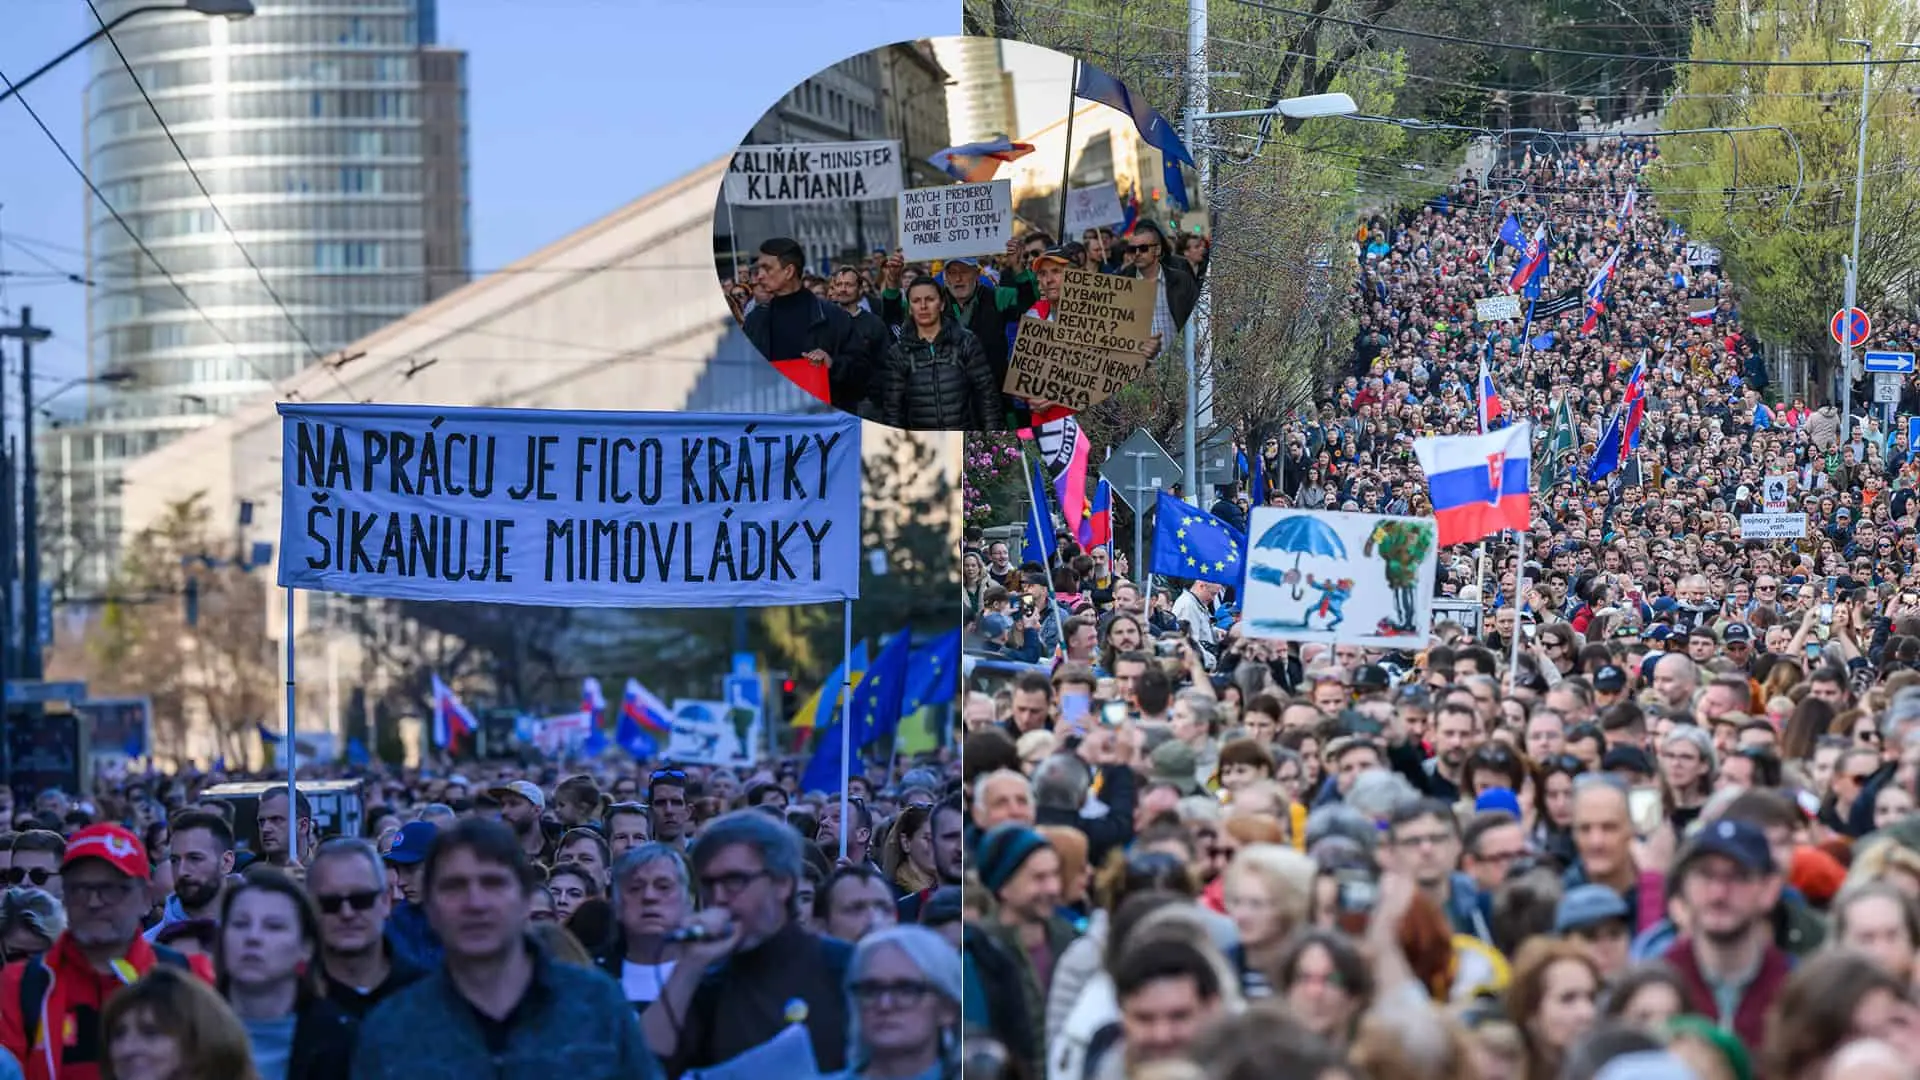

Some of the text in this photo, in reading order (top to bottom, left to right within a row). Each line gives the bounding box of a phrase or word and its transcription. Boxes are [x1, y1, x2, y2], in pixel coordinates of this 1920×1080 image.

[748, 171, 867, 200] KLAMANIA
[905, 206, 924, 219] AKO
[928, 204, 941, 217] JE
[946, 202, 969, 215] FICO
[904, 219, 940, 233] KOPNEM
[913, 232, 941, 245] PADNE
[948, 229, 969, 241] STO
[1064, 271, 1133, 292] KDE SA DA
[1058, 314, 1106, 333] RENTA
[1099, 335, 1135, 351] 4000
[1011, 354, 1044, 375] NECH
[1048, 365, 1098, 391] PAKUJE
[1016, 373, 1090, 408] RUSKA
[297, 415, 840, 504] NA PRÁCU JE FICO KRÁTKY
[306, 492, 832, 582] ŠIKANUJE MIMOVLÁDKY
